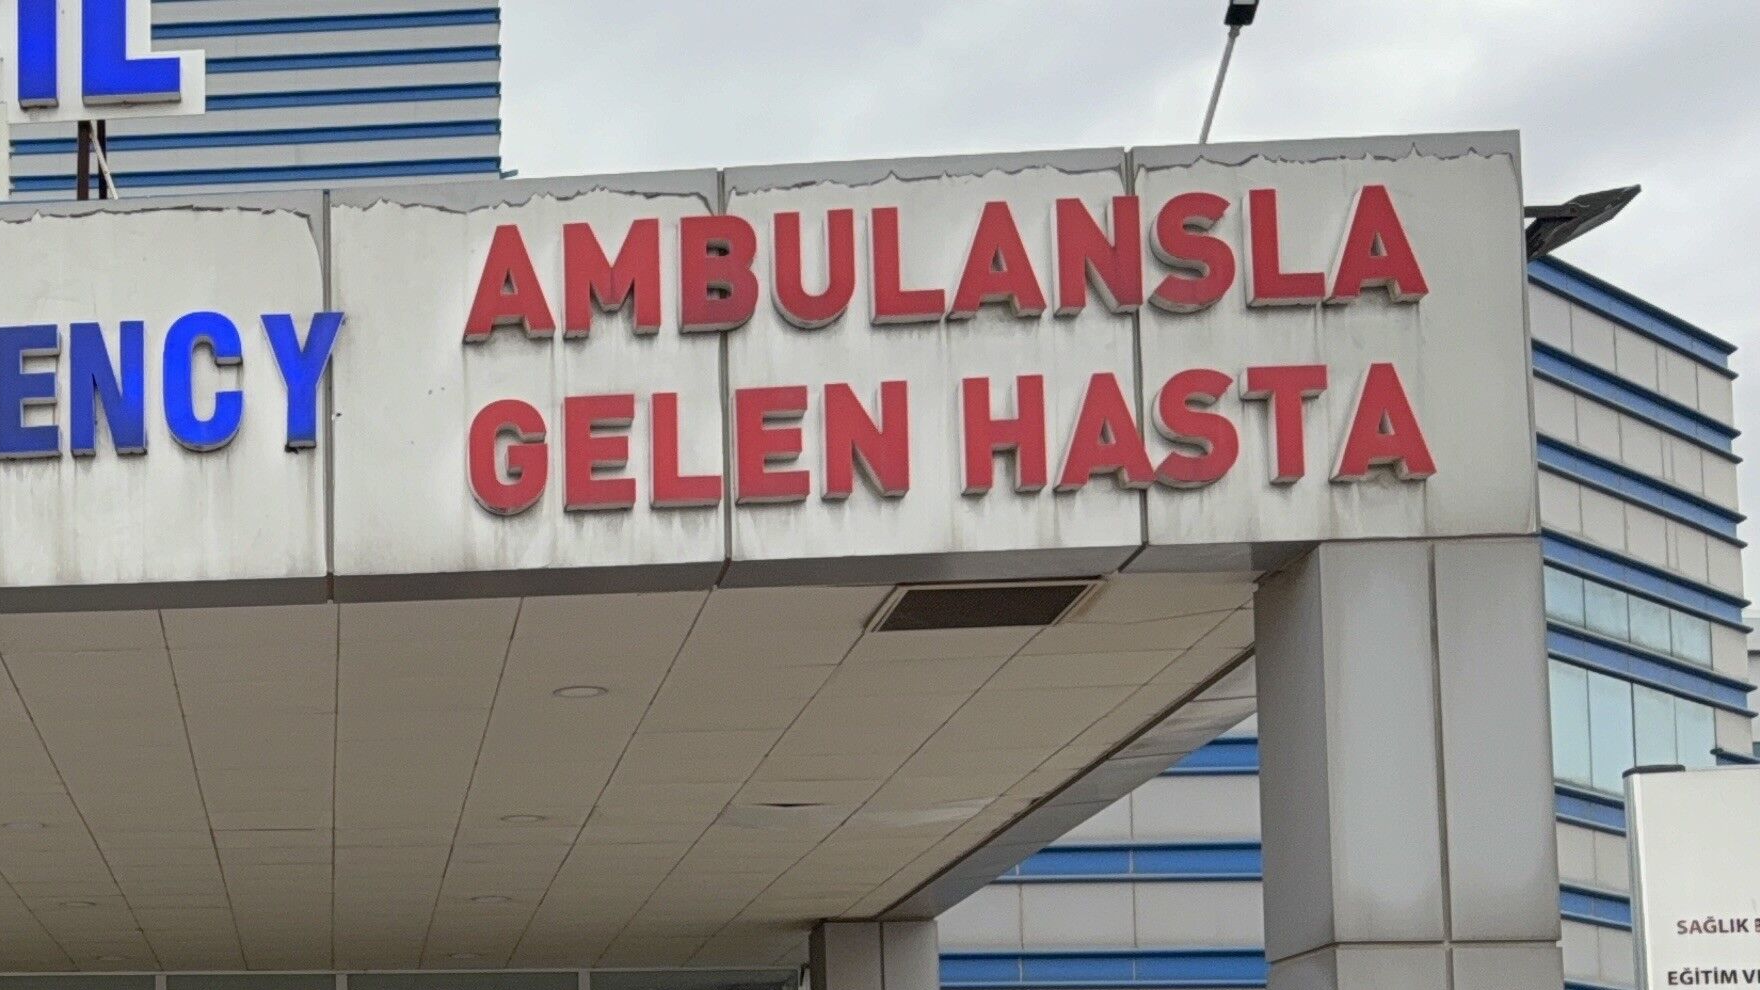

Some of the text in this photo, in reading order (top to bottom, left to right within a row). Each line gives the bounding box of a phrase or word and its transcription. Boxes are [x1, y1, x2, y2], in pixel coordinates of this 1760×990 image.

[464, 185, 1430, 343] AMBULANSLA
[467, 362, 1436, 515] GELEN HASTA
[1676, 916, 1749, 934] SAĞLIK
[1667, 967, 1760, 985] EĞİTİM V
